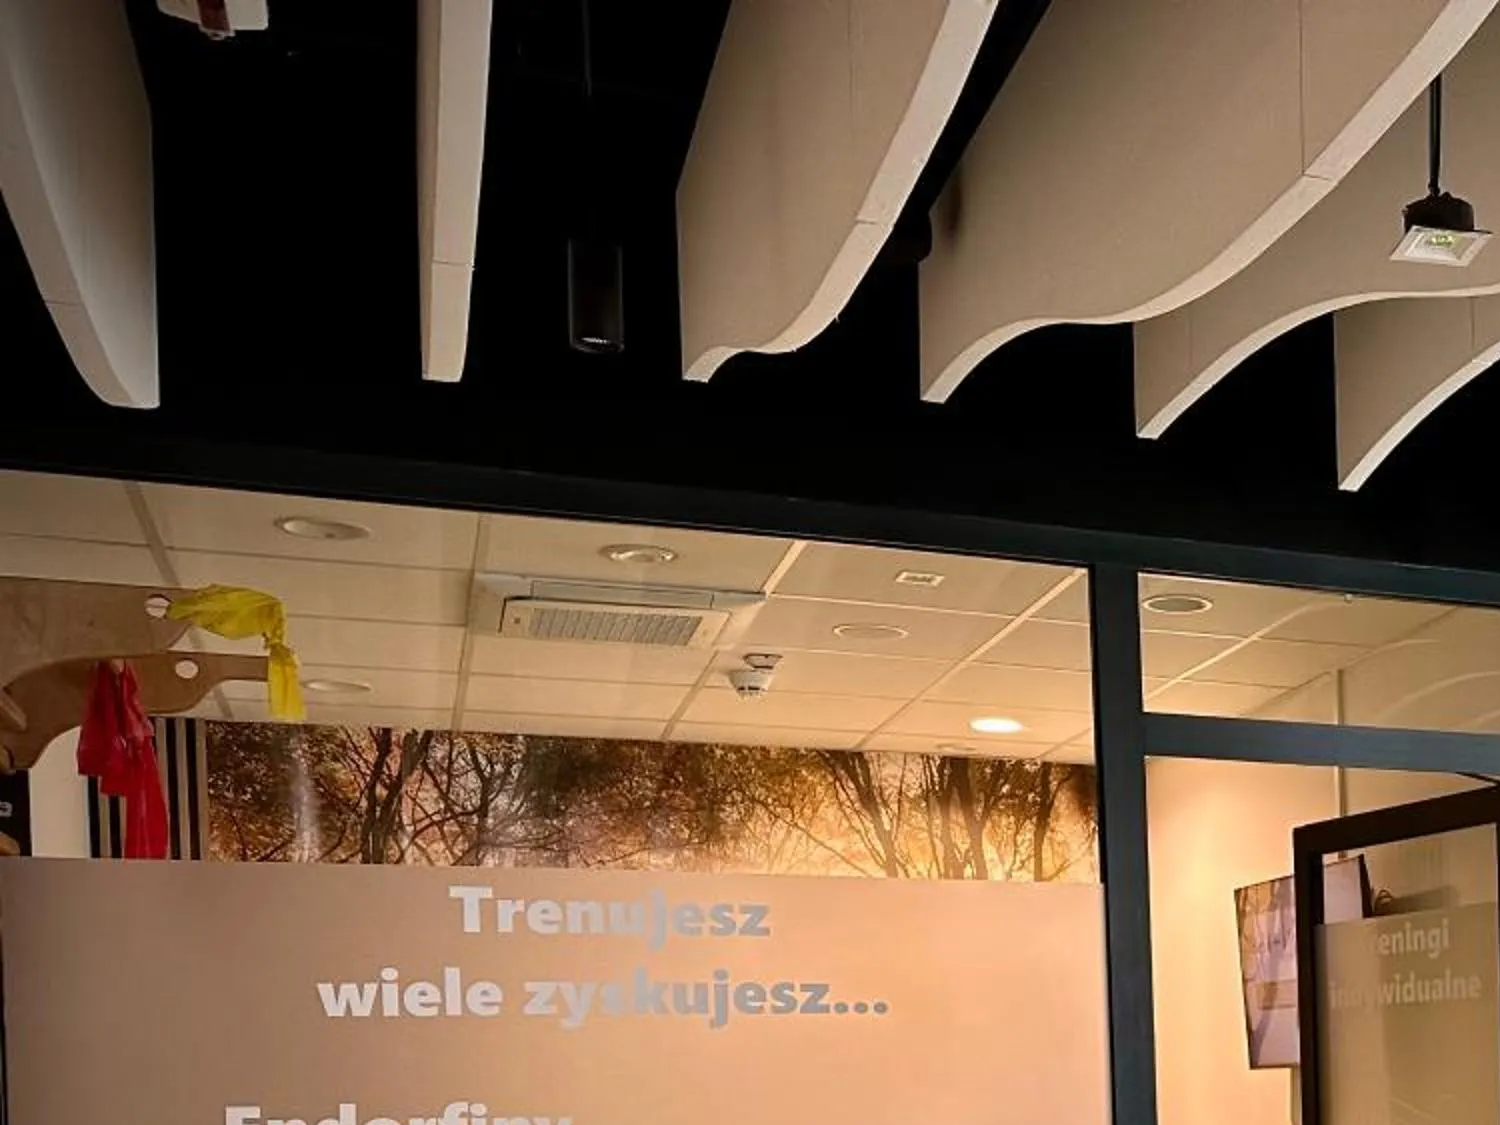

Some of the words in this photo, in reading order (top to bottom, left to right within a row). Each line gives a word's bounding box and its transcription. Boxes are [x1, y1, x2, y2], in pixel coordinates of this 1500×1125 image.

[449, 885, 771, 951] Trenujesz
[1362, 916, 1451, 961] eningi
[317, 967, 502, 1019] wiele
[523, 968, 889, 1029] zyskujesz...
